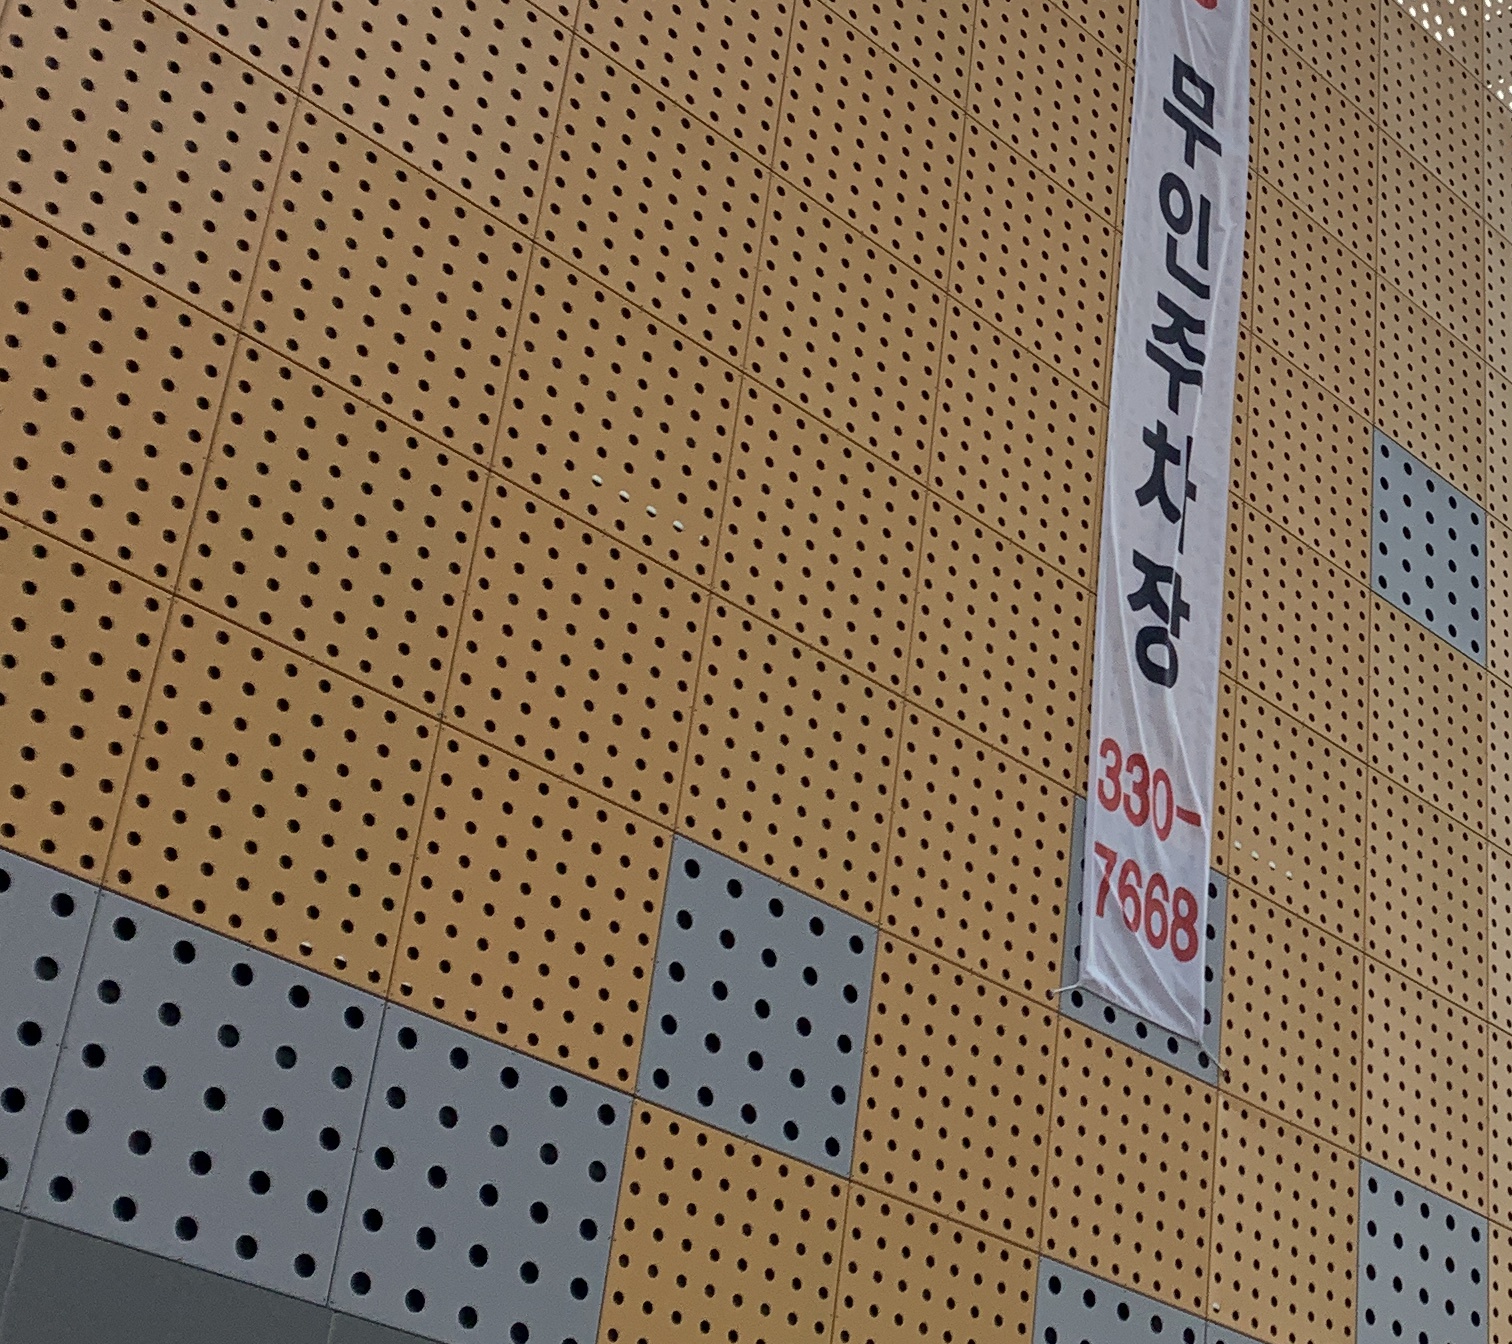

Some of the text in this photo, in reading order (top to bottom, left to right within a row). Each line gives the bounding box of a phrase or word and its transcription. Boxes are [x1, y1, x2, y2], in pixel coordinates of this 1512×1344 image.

[1127, 53, 1222, 689] 무인주차장
[1097, 737, 1201, 842] 330-
[1094, 841, 1199, 962] 7668
